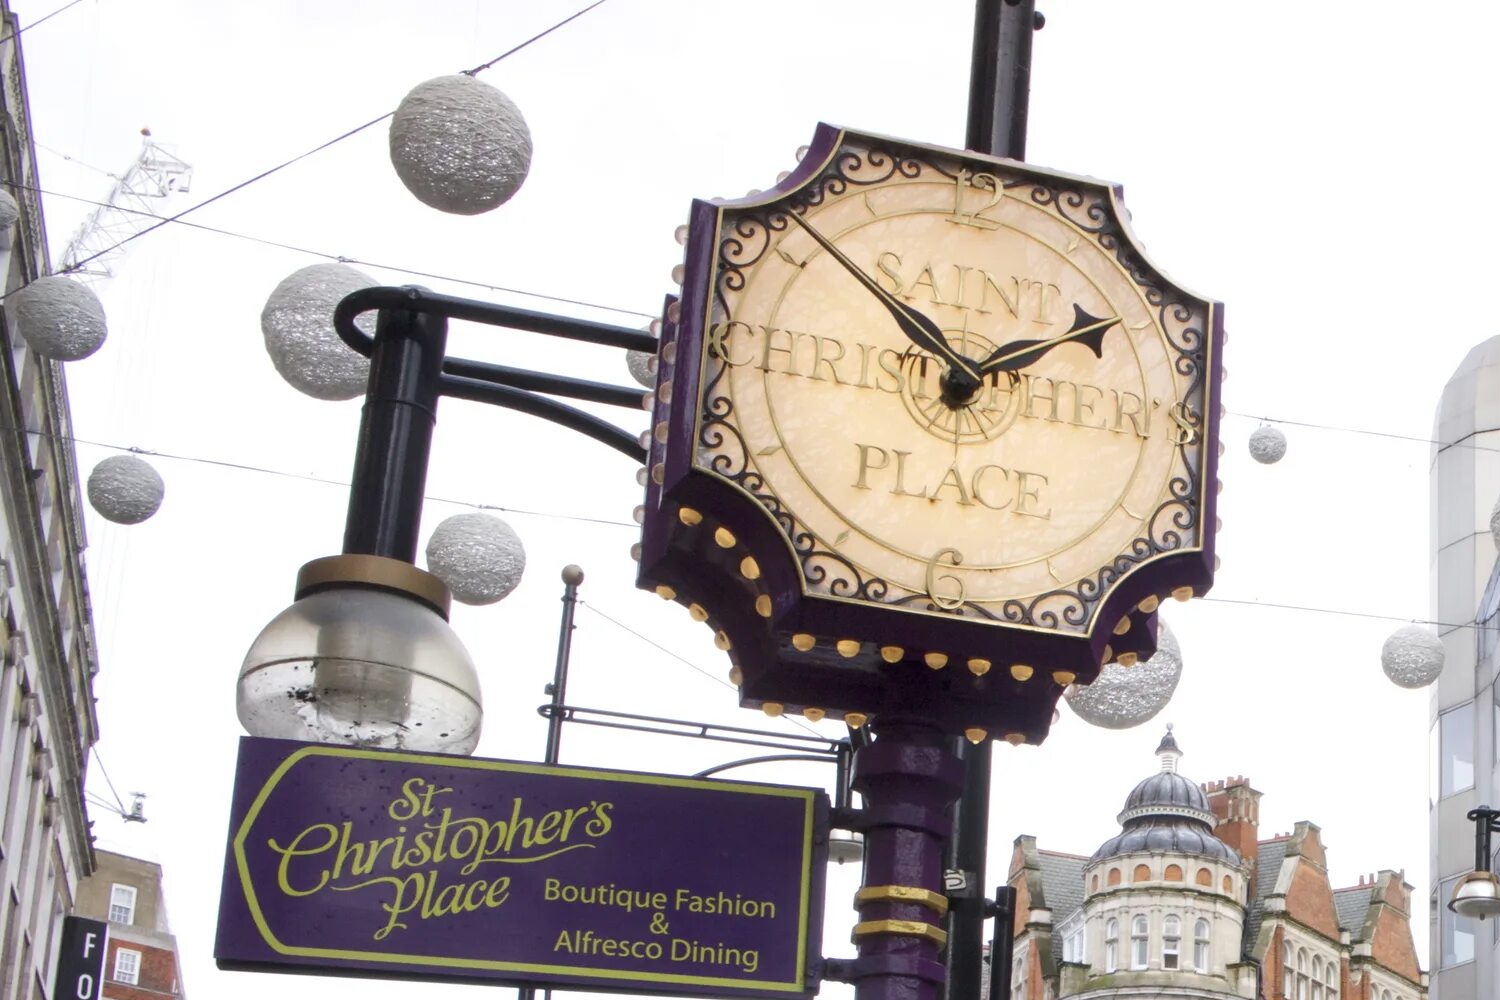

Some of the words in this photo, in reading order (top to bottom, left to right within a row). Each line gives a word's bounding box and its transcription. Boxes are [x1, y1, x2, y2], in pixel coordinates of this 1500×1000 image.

[957, 168, 1004, 231] 12
[876, 251, 1061, 326] SAINT
[710, 320, 1196, 446] CHRISTPHER'S
[852, 443, 1052, 520] PLACE
[927, 547, 967, 610] 6
[389, 778, 454, 821] St
[268, 797, 613, 897] Christopher's
[331, 876, 510, 941] Place
[544, 879, 667, 911] Boutique
[674, 889, 777, 919] Fashion
[650, 912, 670, 935] &
[554, 930, 662, 960] Alfresco
[671, 939, 760, 972] Dining
